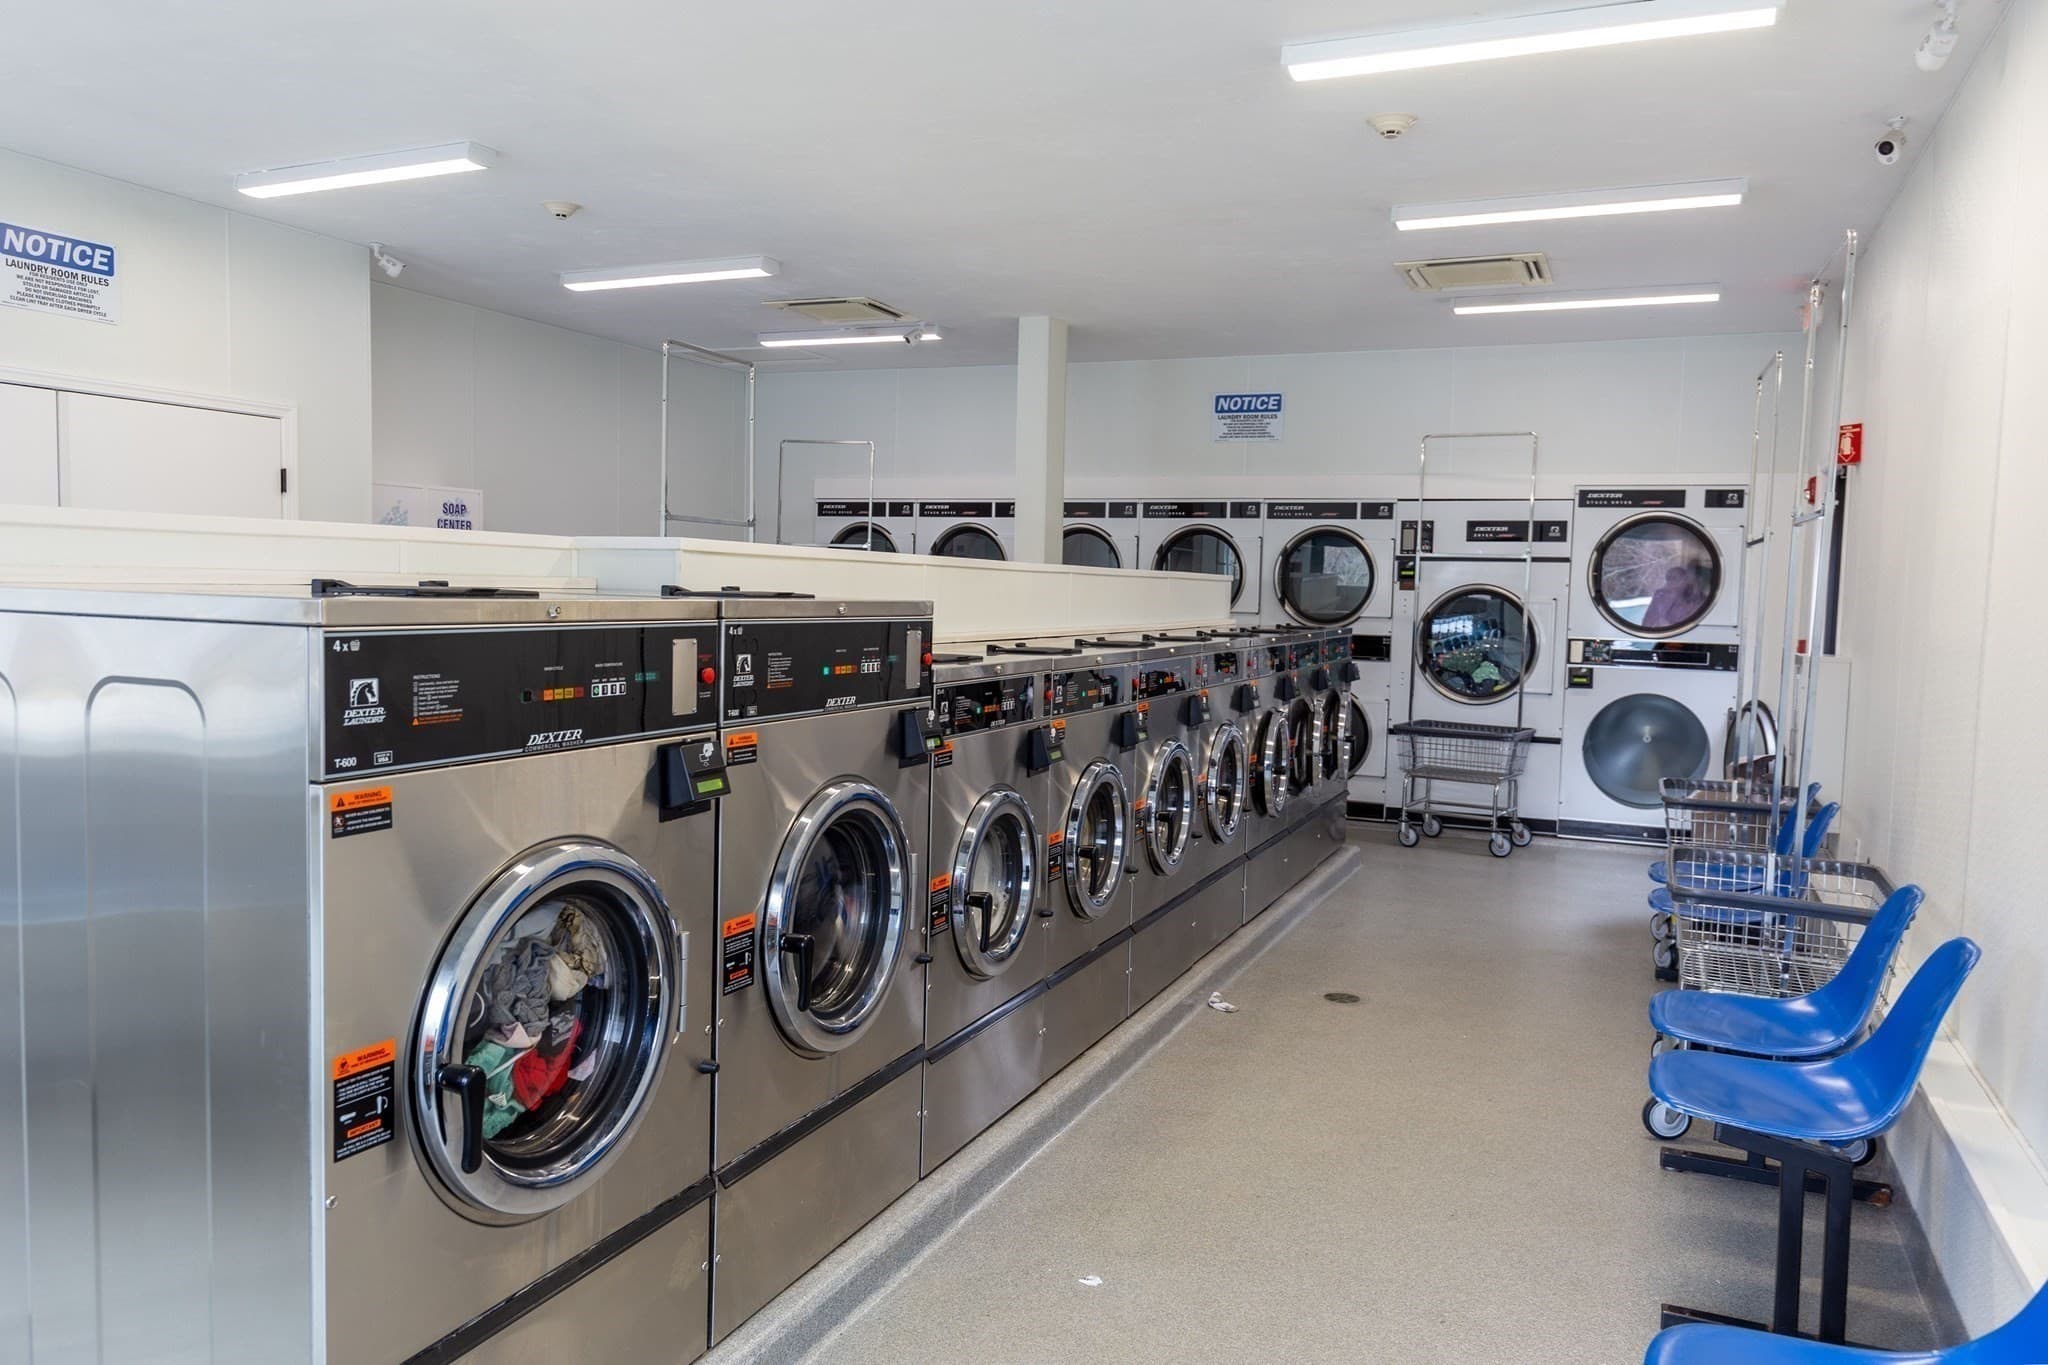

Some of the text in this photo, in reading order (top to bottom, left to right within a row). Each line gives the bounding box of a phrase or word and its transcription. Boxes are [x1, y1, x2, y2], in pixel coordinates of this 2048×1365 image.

[3, 228, 112, 271] NOTICE
[5, 258, 109, 287] LAUNDRY ROOM RULES
[45, 280, 77, 290] RESPONSIBLE
[43, 290, 68, 299] OVERLOAD
[68, 295, 93, 304] MACHINES
[49, 286, 72, 295] DAMAGED
[73, 291, 94, 299] ARTICLES
[16, 290, 101, 311] PLEASE REMOVE CLOTHES PROMPTLY
[1217, 396, 1281, 411] NOTICE
[442, 502, 467, 515] SOAP
[437, 518, 472, 530] CENTER
[825, 696, 856, 707] DEXTER
[343, 707, 385, 719] DEXTER
[527, 728, 582, 746] DEXTER
[524, 743, 561, 752] COMMERCIAL
[333, 757, 357, 768] T-600
